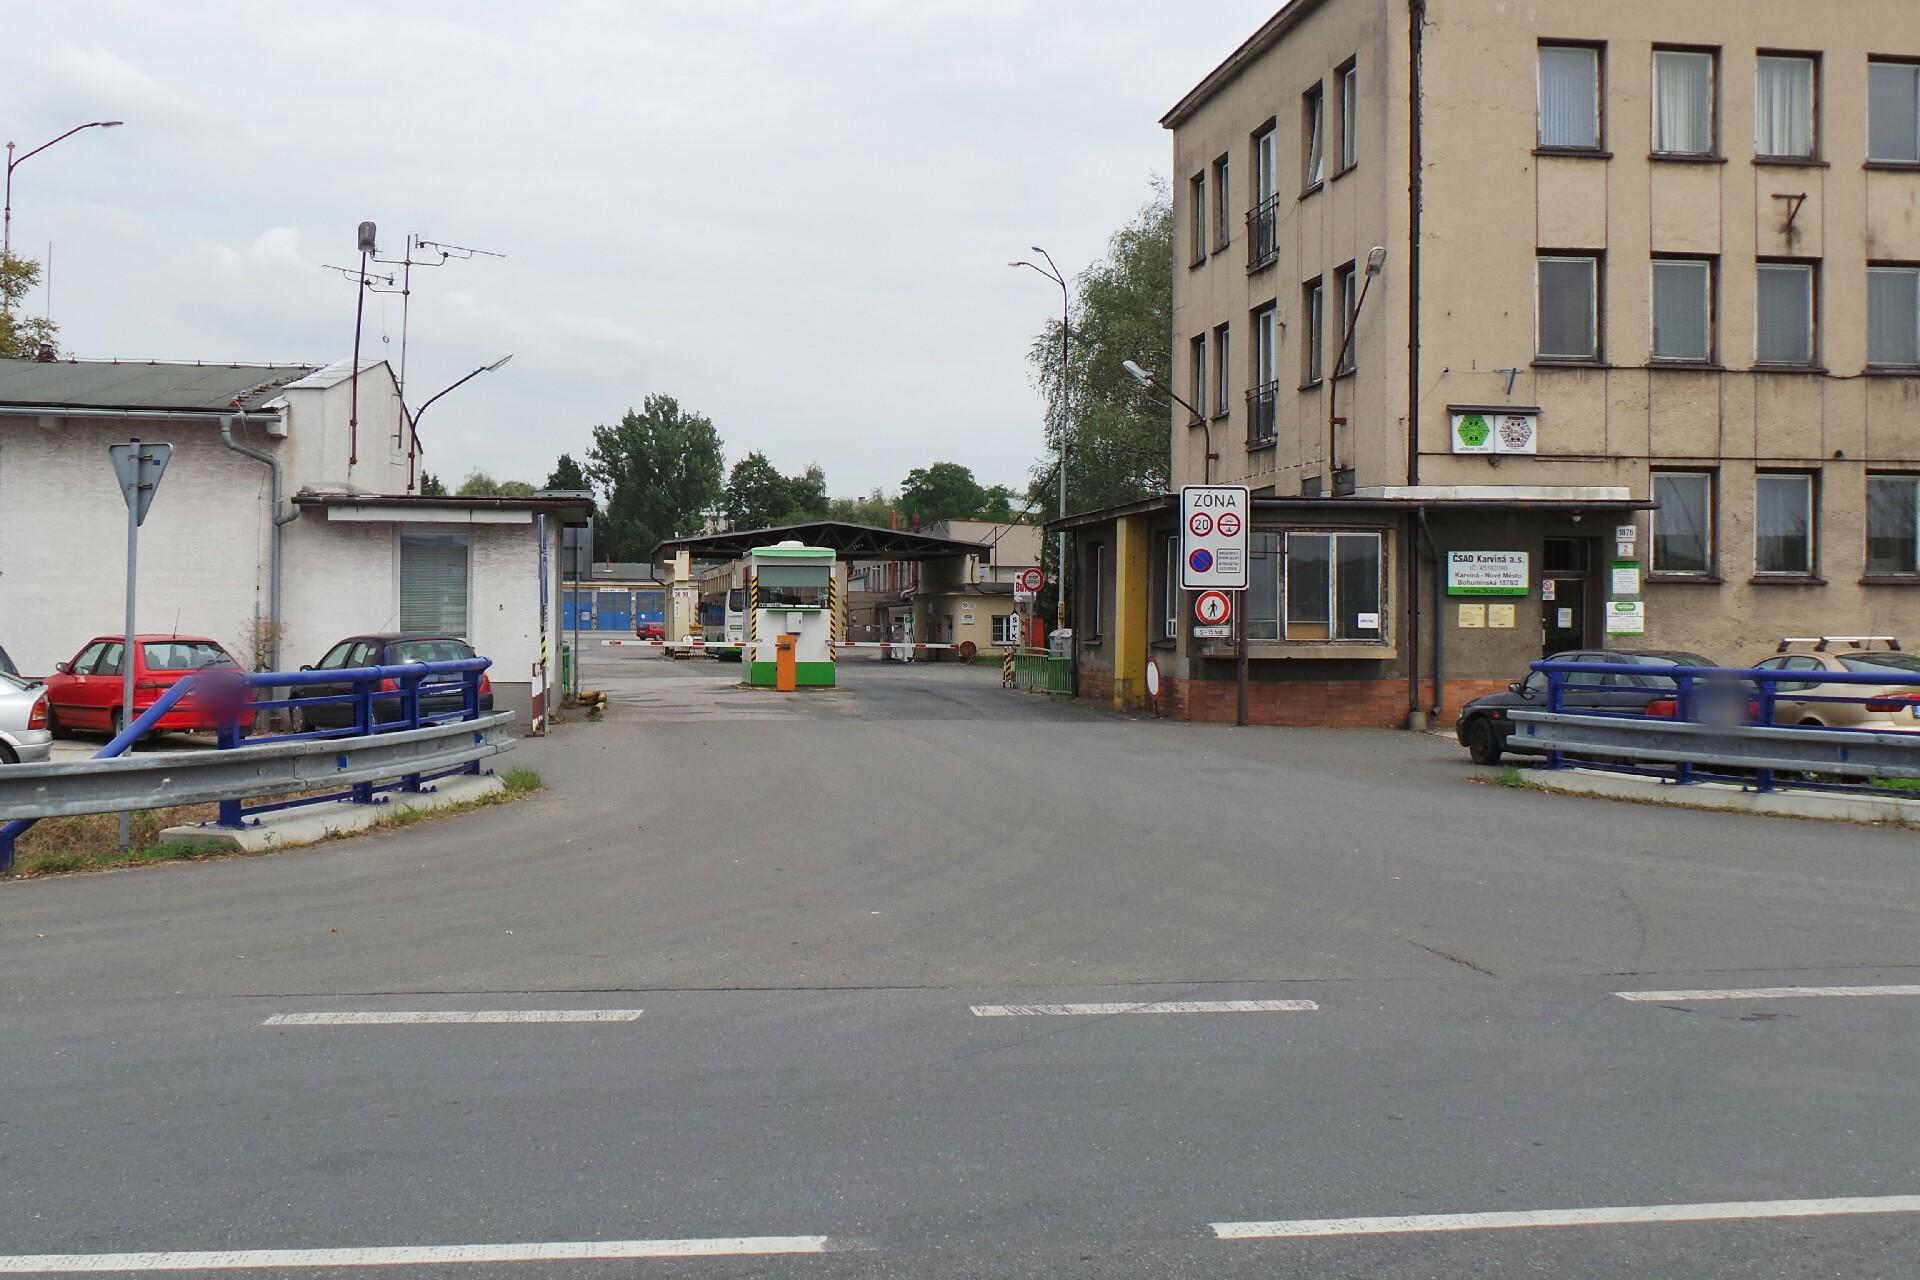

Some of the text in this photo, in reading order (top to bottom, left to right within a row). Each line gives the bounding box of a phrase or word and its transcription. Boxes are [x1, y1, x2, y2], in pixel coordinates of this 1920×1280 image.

[1194, 491, 1236, 507] ZÓNA
[1195, 519, 1209, 530] 20
[1618, 528, 1634, 536] 1876
[1623, 544, 1628, 552] 2
[1452, 552, 1525, 564] ČSAD Karviná a.s.
